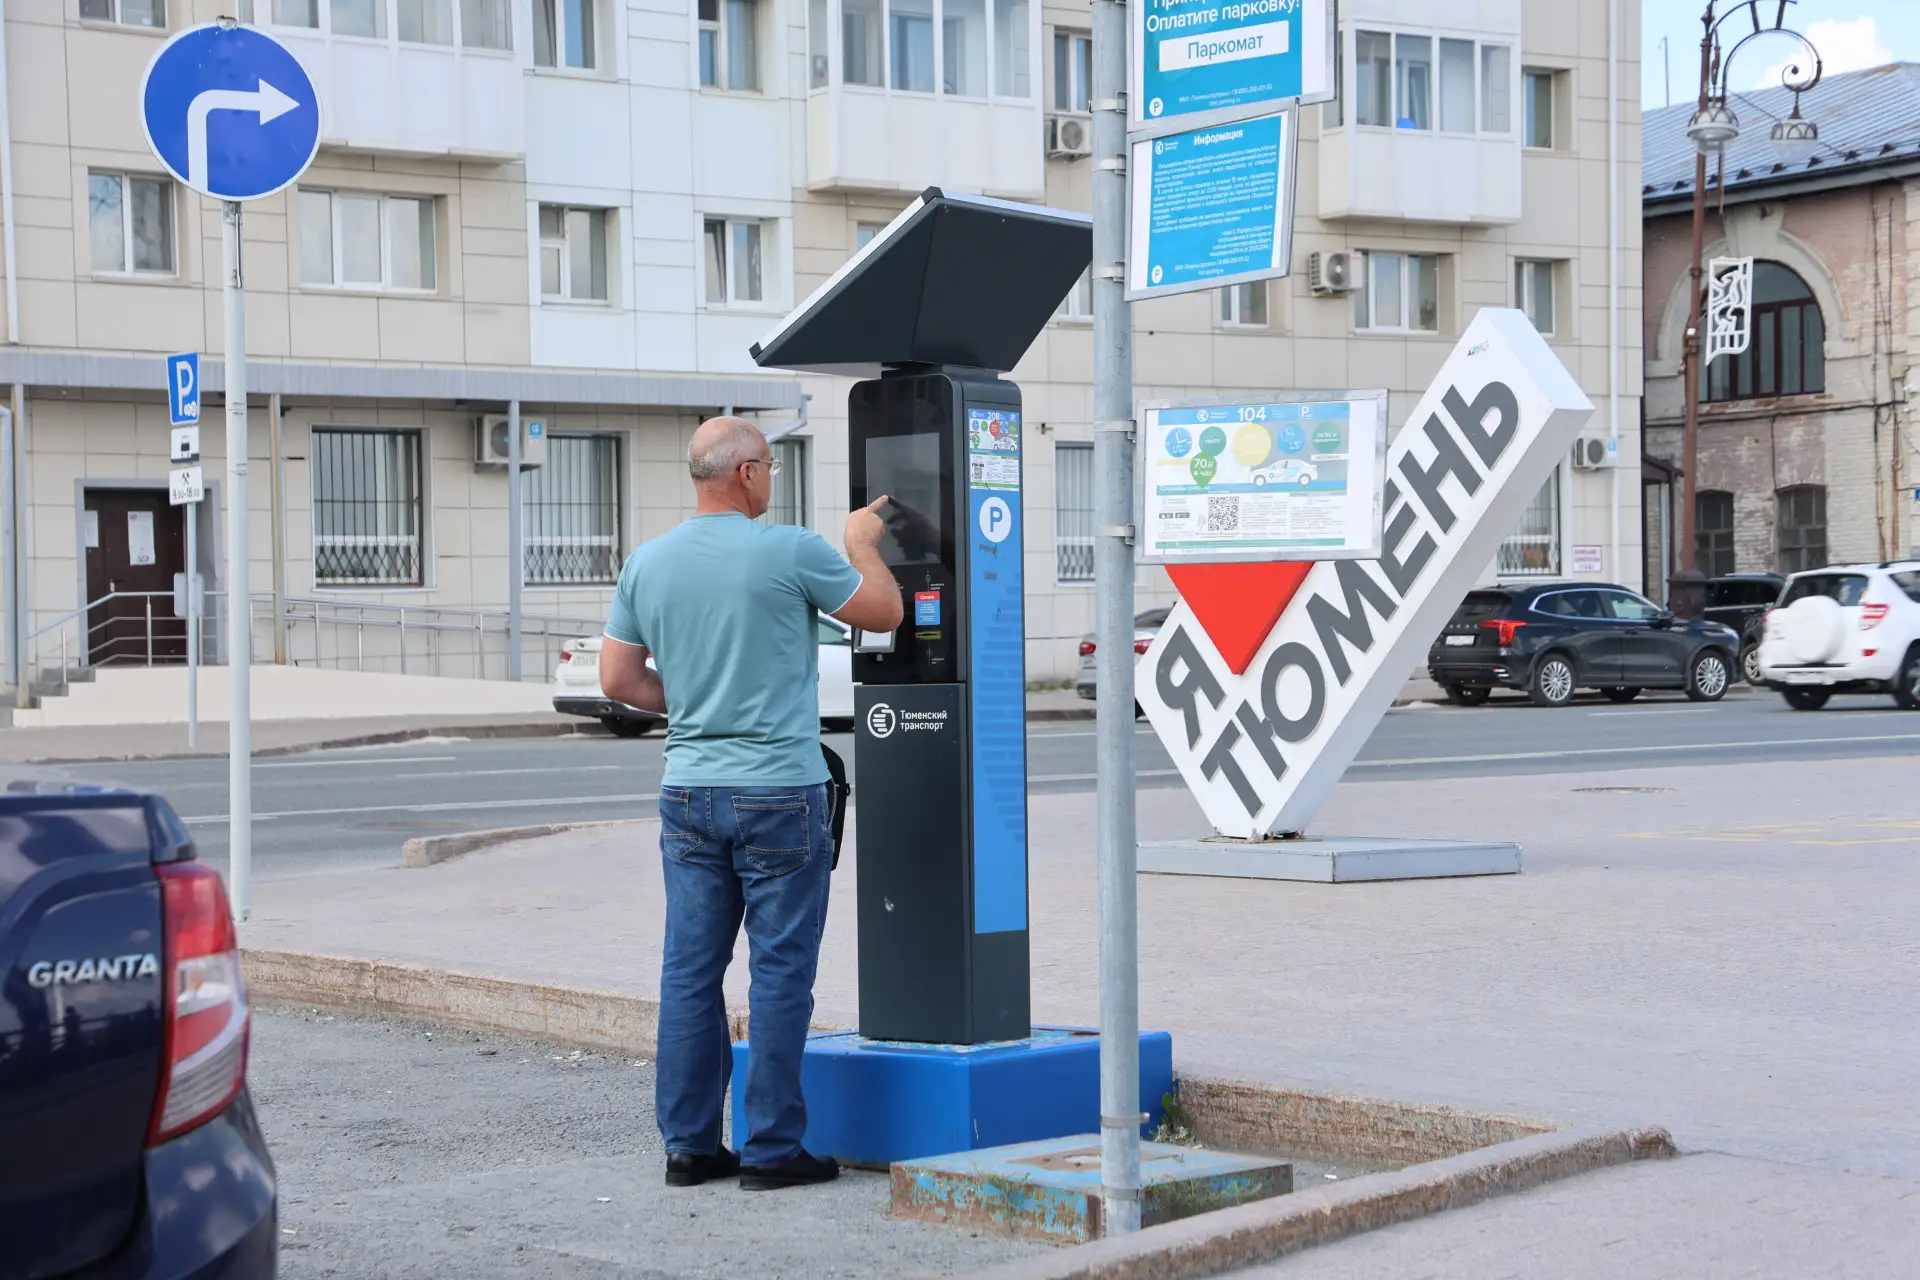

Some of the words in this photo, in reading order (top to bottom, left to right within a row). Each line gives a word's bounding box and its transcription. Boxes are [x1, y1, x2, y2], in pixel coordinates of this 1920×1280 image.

[1146, 8, 1218, 32] Оплатите
[1188, 35, 1263, 60] Паркомат
[1193, 129, 1244, 147] Информация
[176, 360, 194, 417] P
[987, 411, 1000, 421] 208
[1238, 406, 1266, 422] 104
[1193, 458, 1207, 469] 70
[990, 506, 1003, 532] P
[1200, 381, 1520, 819] ТЮМЕНЬ
[1155, 624, 1227, 751] Я
[899, 709, 948, 720] Тюменский
[900, 722, 944, 732] транспорт
[27, 953, 159, 988] GRANTA
